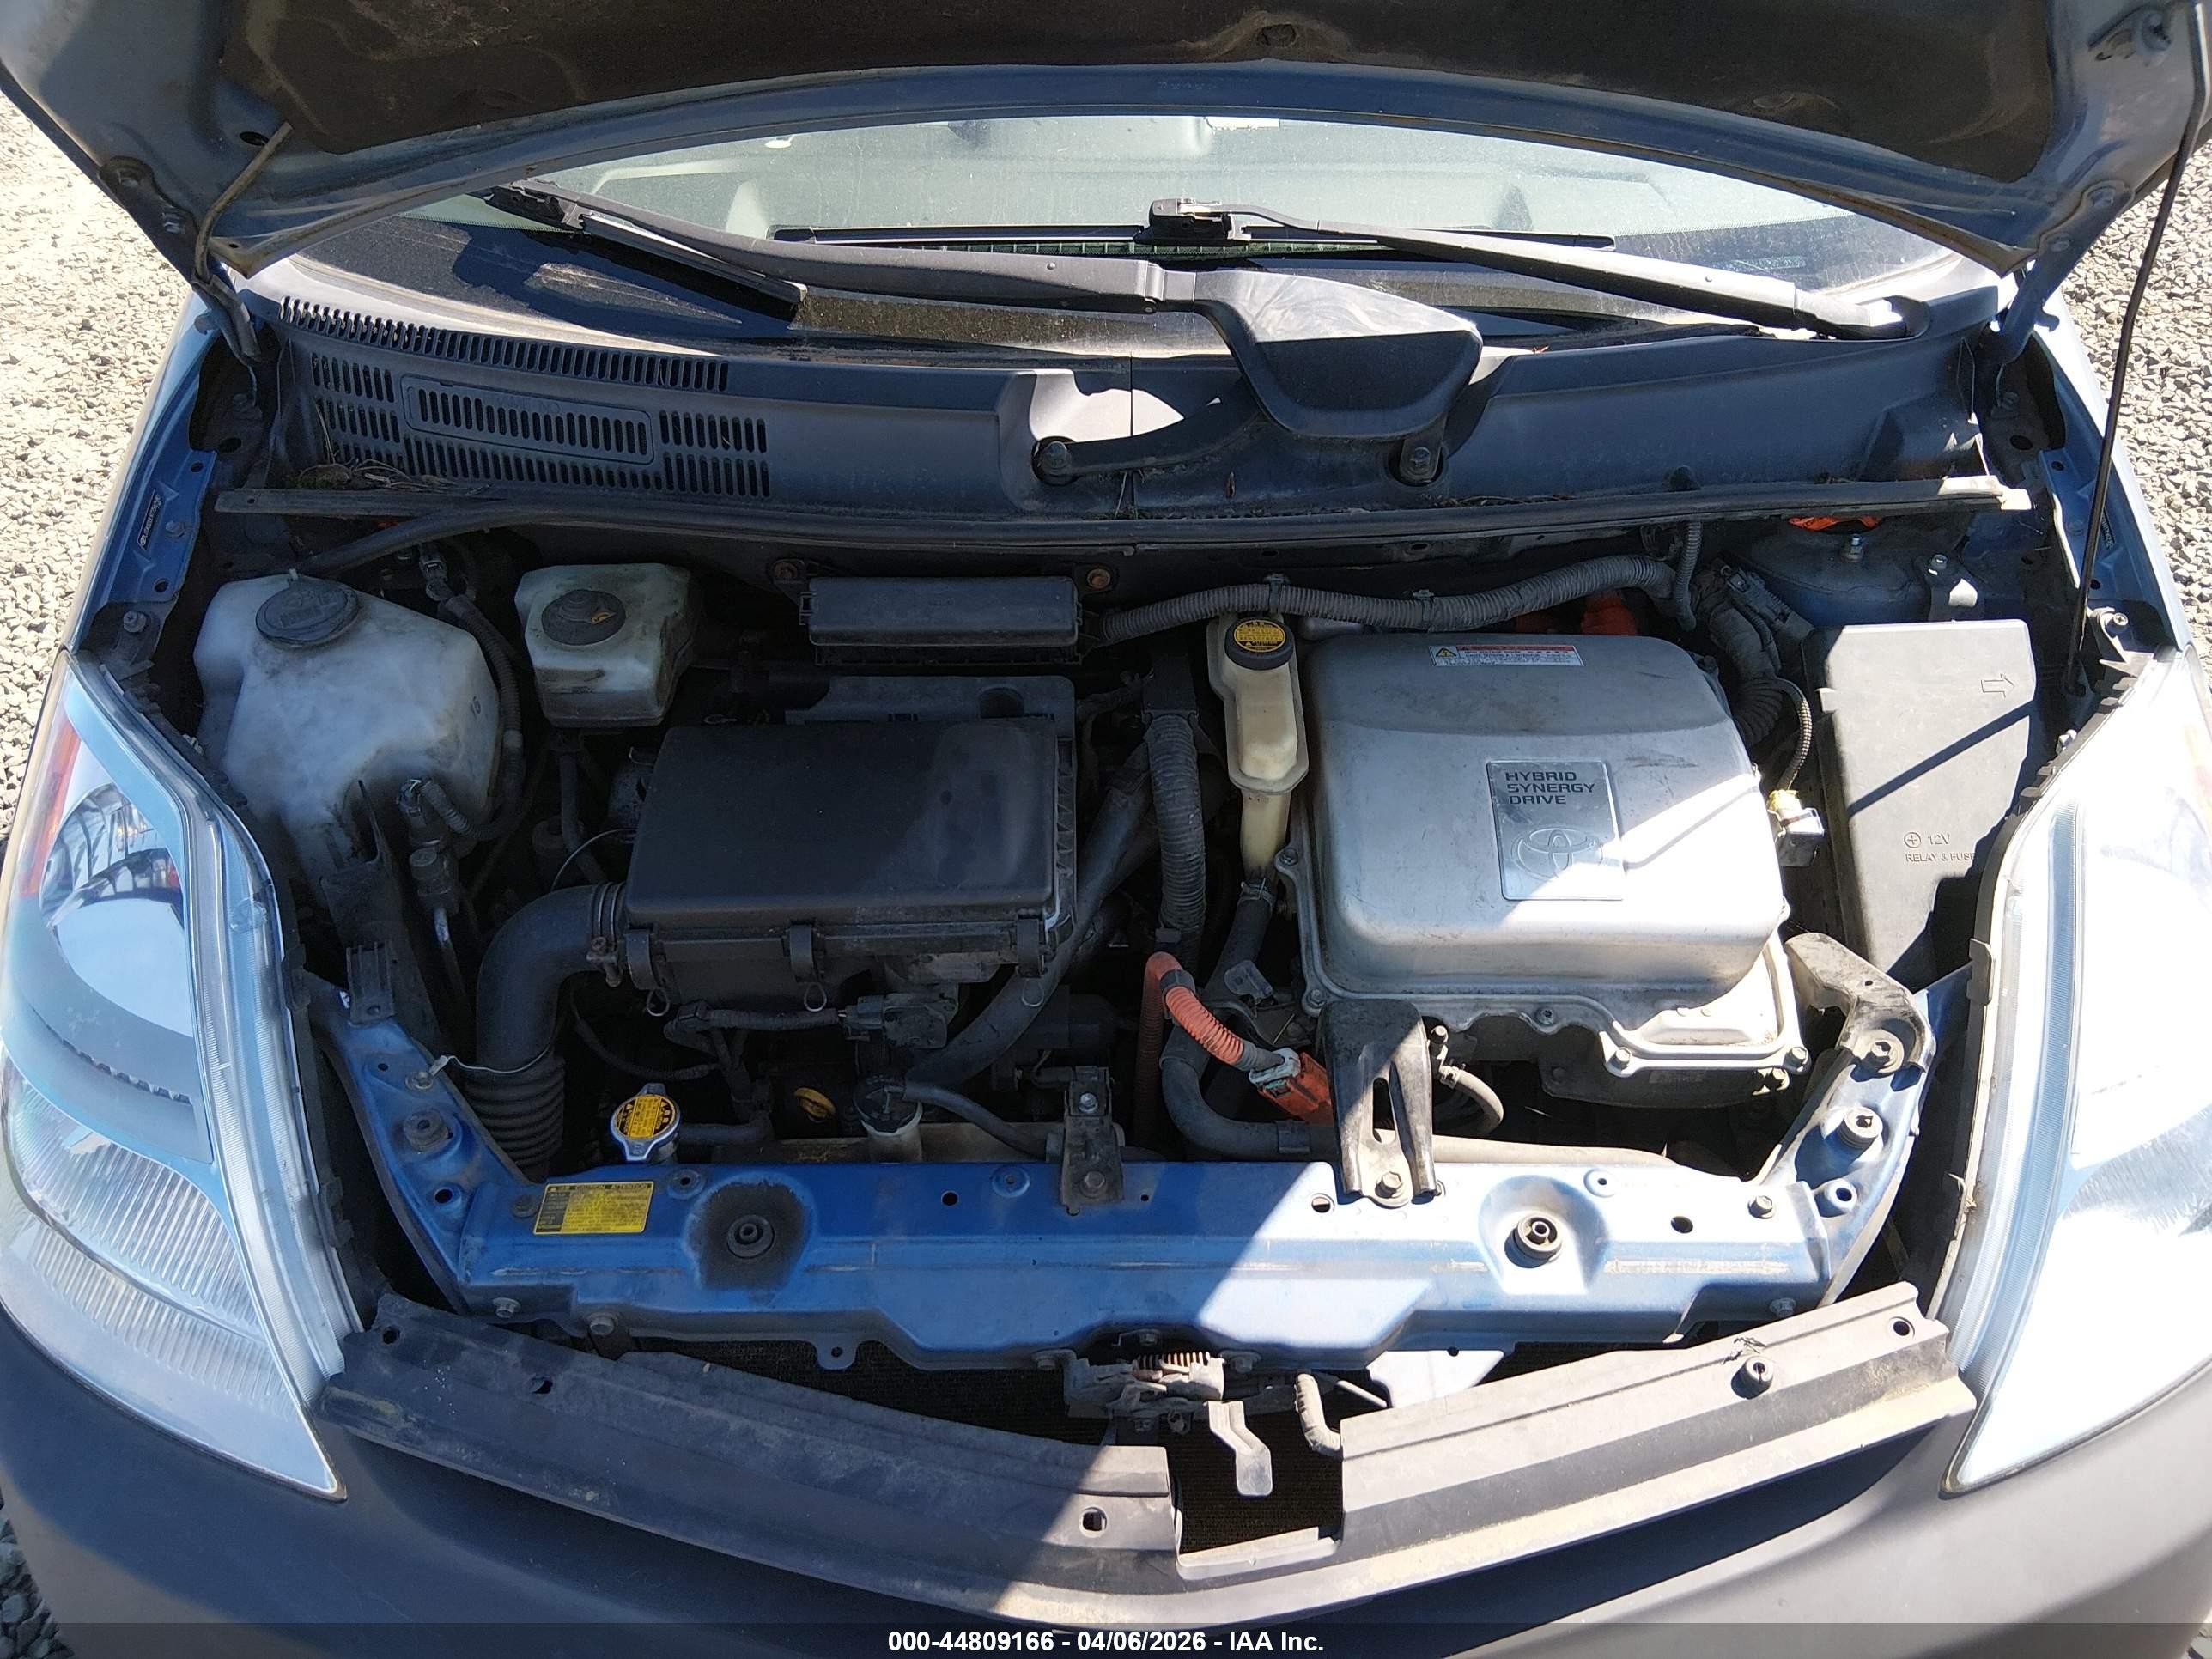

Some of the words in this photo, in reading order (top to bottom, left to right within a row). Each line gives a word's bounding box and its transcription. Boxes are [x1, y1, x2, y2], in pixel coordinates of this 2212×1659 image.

[1505, 771, 1577, 781] HYBRID
[1507, 783, 1595, 793] SYNERGY
[1510, 795, 1567, 805] DRIVE
[1928, 833, 1950, 845] 12V
[1905, 852, 1937, 862] RELAY
[1941, 853, 1948, 861] &
